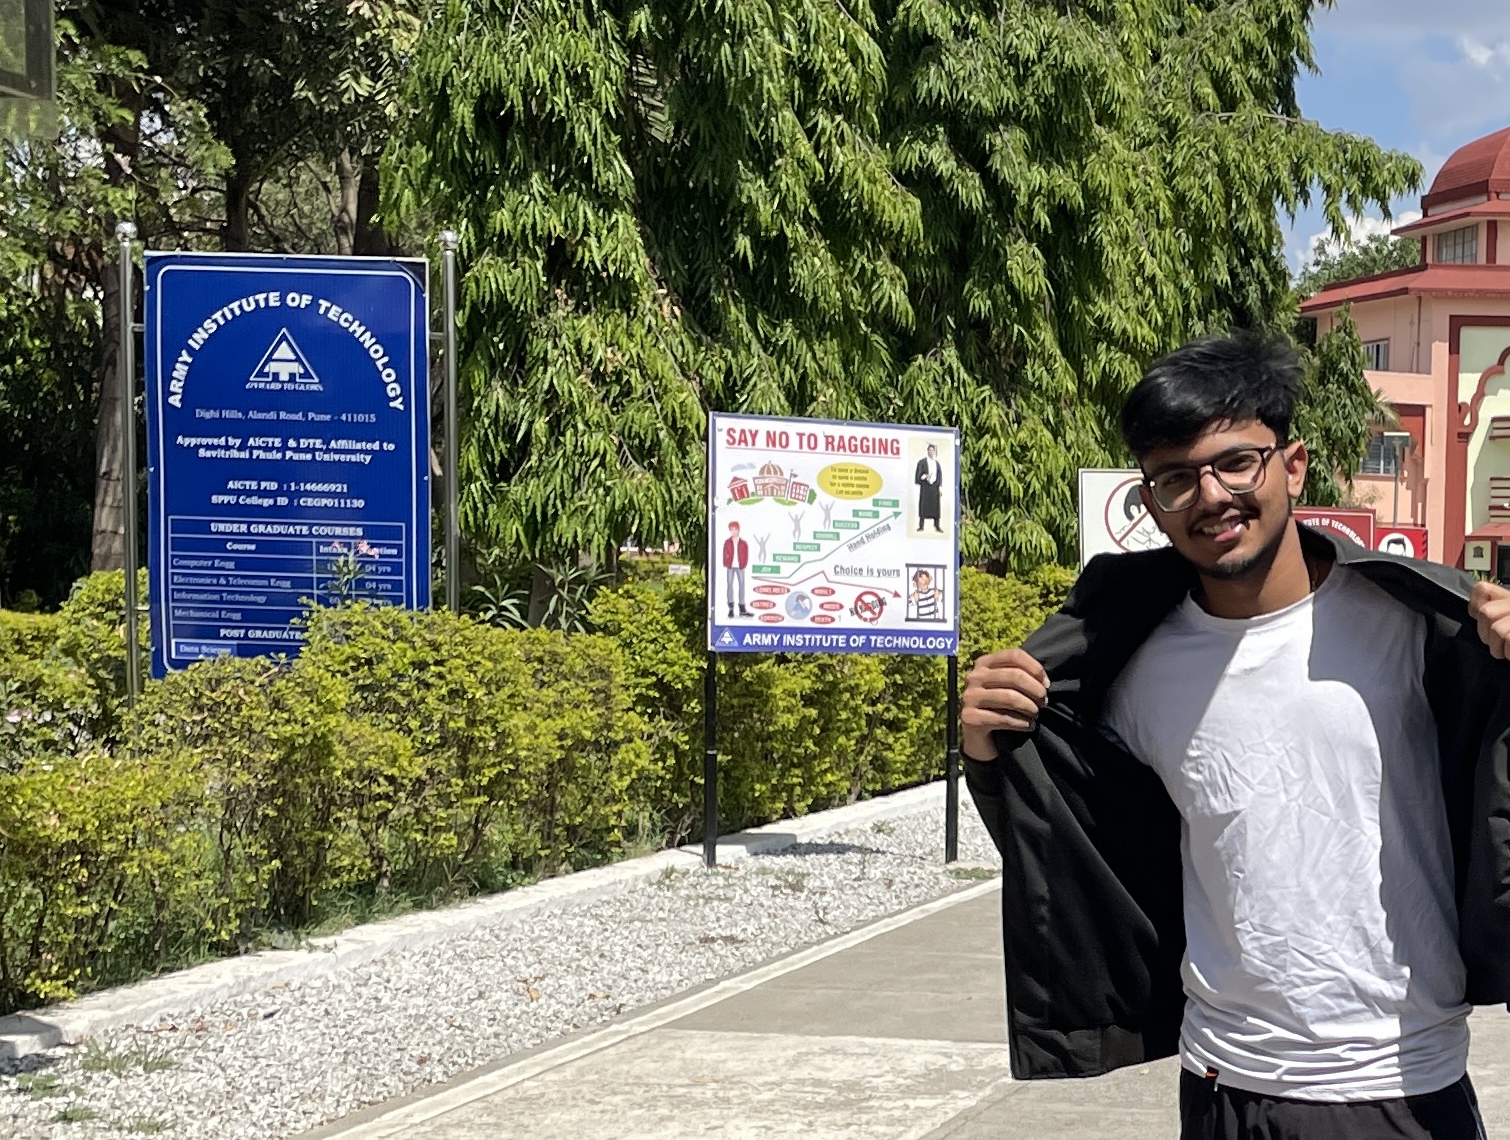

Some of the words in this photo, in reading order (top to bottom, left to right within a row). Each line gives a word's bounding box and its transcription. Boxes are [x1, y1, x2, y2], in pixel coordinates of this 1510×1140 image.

[167, 349, 193, 408] ARMY
[188, 291, 281, 350] INSTITUTE
[286, 292, 313, 309] OF
[318, 299, 404, 411] TECHNOLOGY
[307, 412, 331, 421] Pune
[340, 413, 376, 423] 411015
[176, 435, 226, 447] Approved
[227, 436, 242, 448] by
[247, 437, 282, 448] AICTE
[287, 438, 297, 448] &
[299, 438, 327, 450] DTE,
[328, 439, 380, 450] Affiliated
[382, 441, 395, 451] to
[725, 427, 759, 448] SAY
[766, 430, 789, 448] NO
[796, 431, 817, 451] TO
[824, 434, 900, 456] RAGGING
[198, 447, 250, 459] Savitribai
[252, 449, 282, 460] Phule
[285, 450, 313, 461] Pune
[315, 451, 372, 465] University
[227, 480, 258, 490] AICTE
[260, 481, 278, 491] PID
[211, 495, 237, 505] SPPU
[239, 495, 274, 507] College
[277, 496, 289, 506] ID
[210, 522, 248, 533] UNDER
[250, 523, 309, 535] GRADUATE
[312, 525, 363, 536] COURSES
[847, 536, 866, 553] Hand
[865, 523, 892, 542] Holding
[226, 542, 256, 551] Course
[173, 558, 213, 568] Computer
[834, 564, 864, 576] Choice
[866, 565, 874, 576] is
[876, 567, 900, 578] yours
[173, 591, 220, 601] Information
[221, 593, 267, 604] Technology
[220, 628, 245, 638] POST
[248, 629, 302, 639] GRADUATE
[743, 633, 779, 647] ARMY
[783, 634, 846, 648] INSTITUTE
[850, 635, 867, 648] OF
[870, 635, 953, 650] TECHNOLOGY
